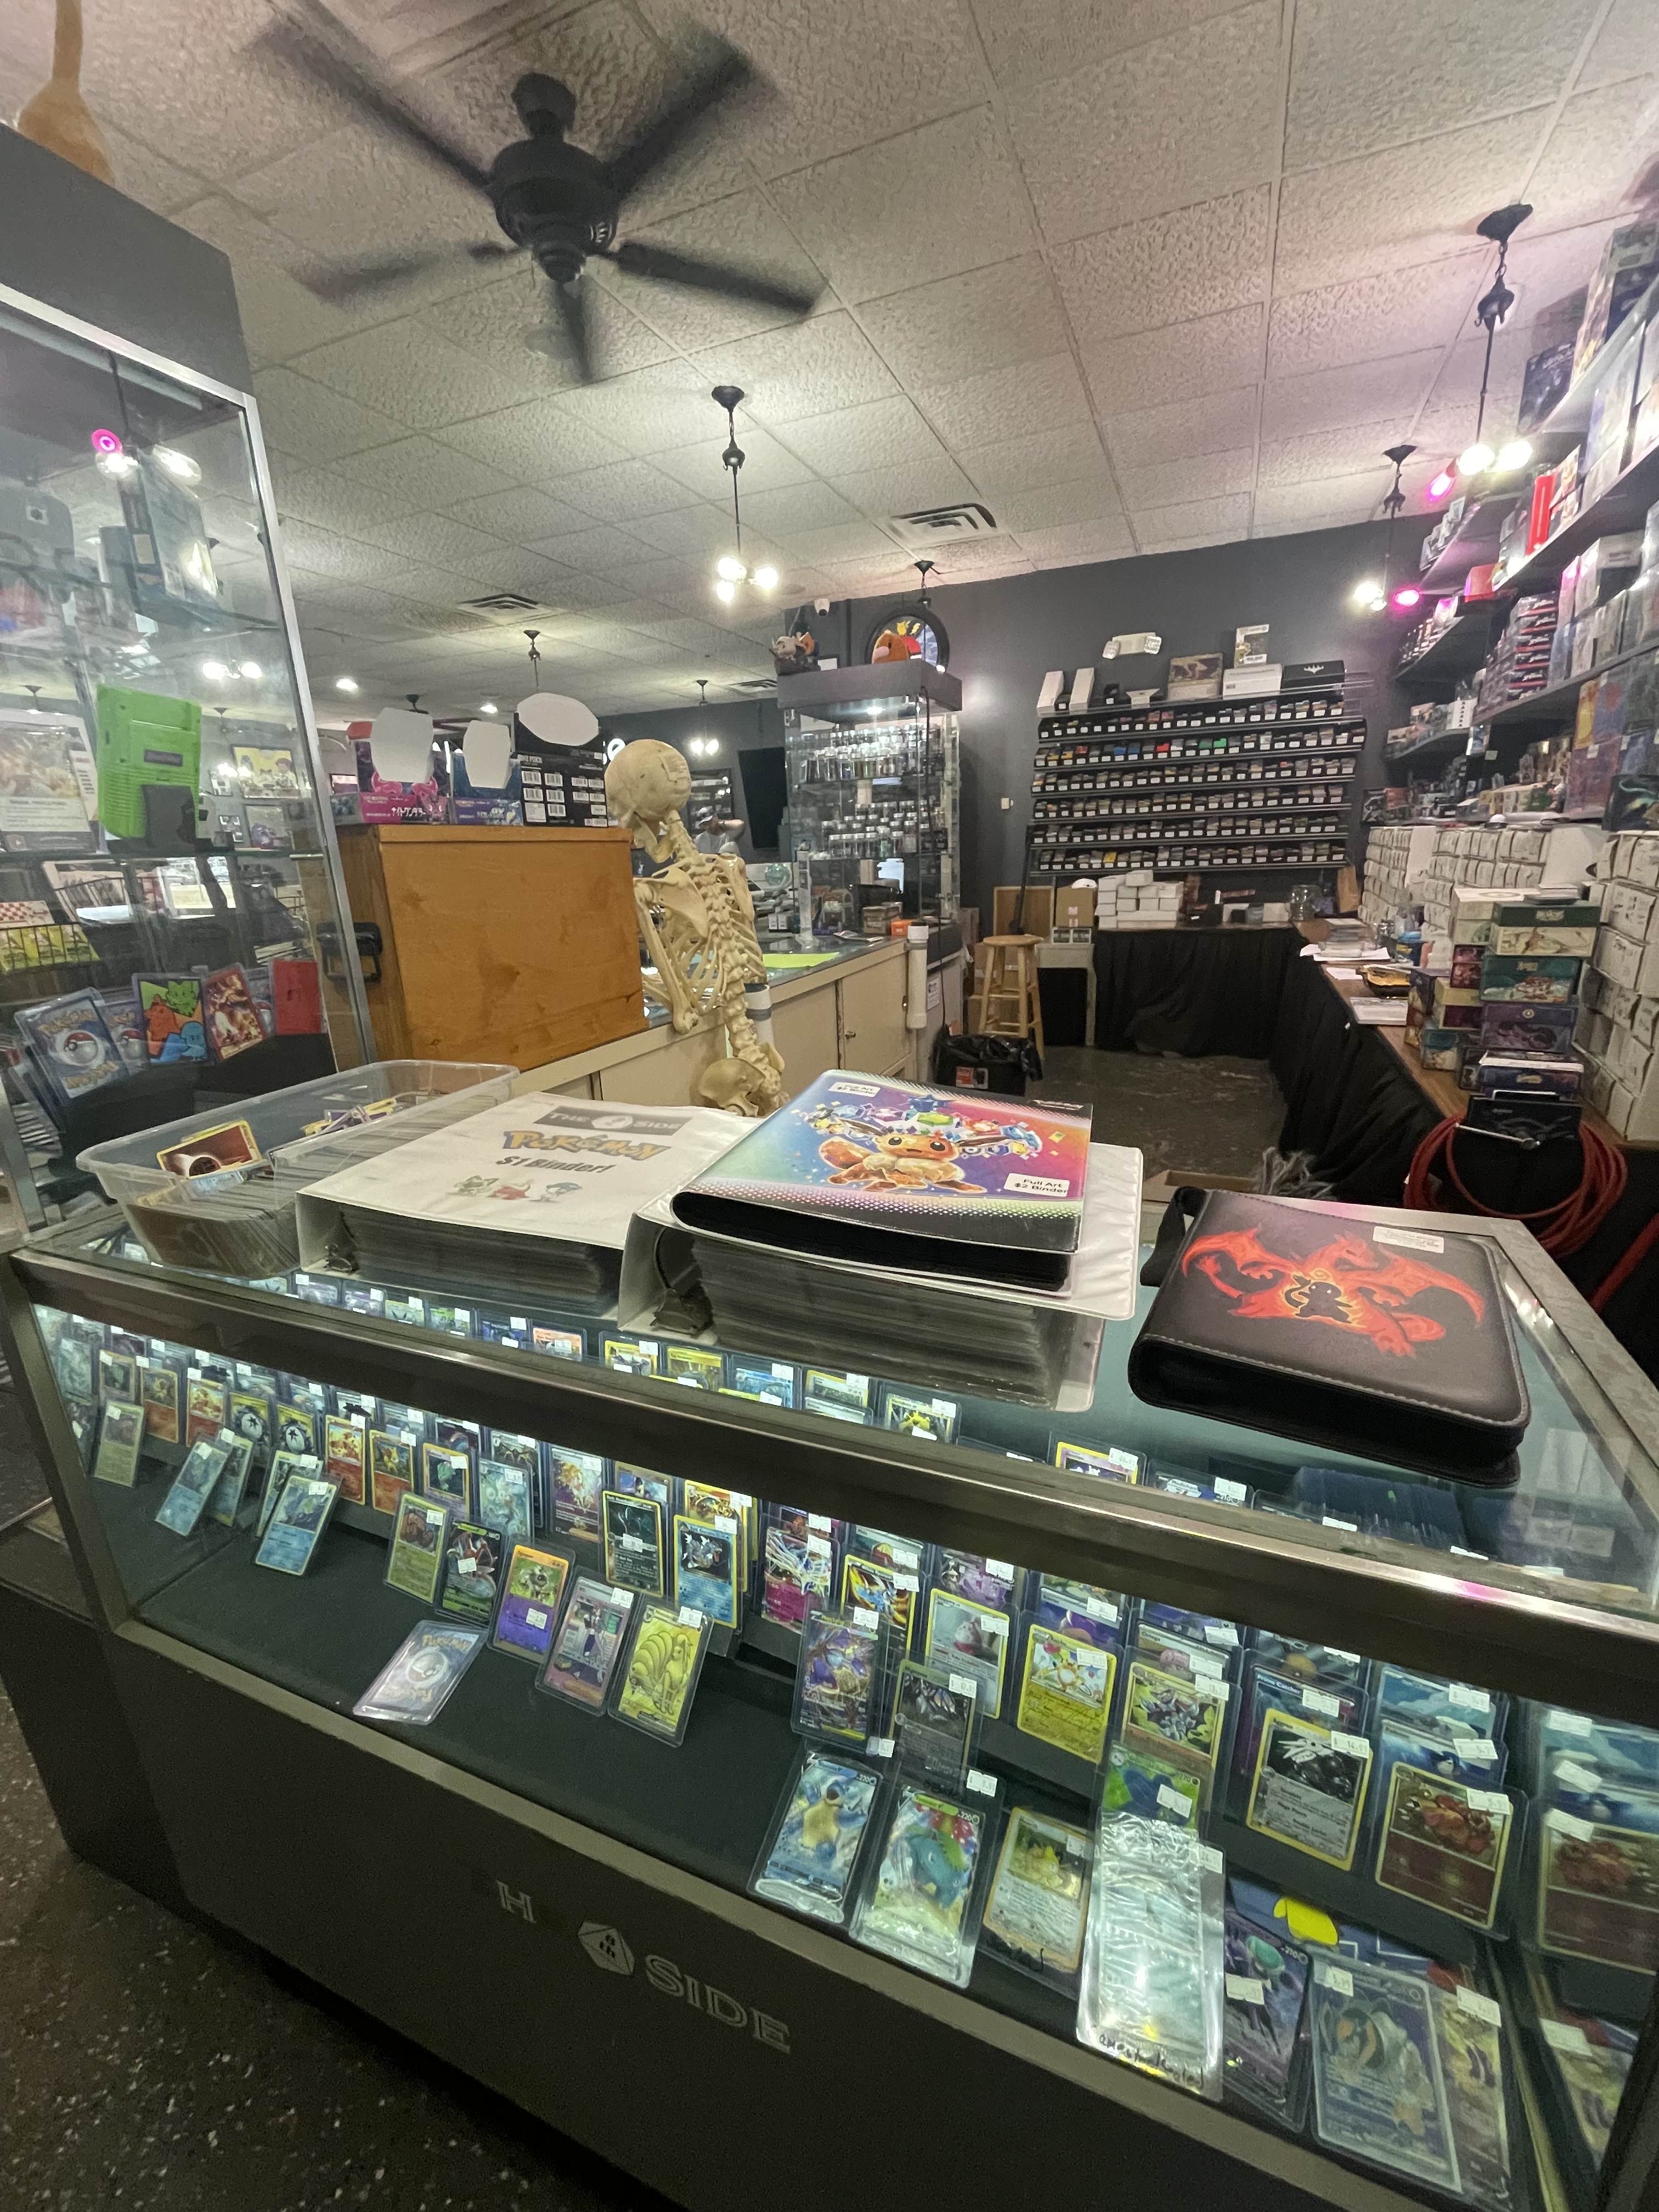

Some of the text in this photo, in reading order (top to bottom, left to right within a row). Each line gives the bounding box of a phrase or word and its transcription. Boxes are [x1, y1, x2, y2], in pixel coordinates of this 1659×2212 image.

[548, 1112, 591, 1122] THE
[633, 1120, 682, 1129] SIDE
[1031, 1186, 1067, 1194] Binder
[495, 1881, 536, 1923] H
[645, 1954, 791, 2055] SIDE
